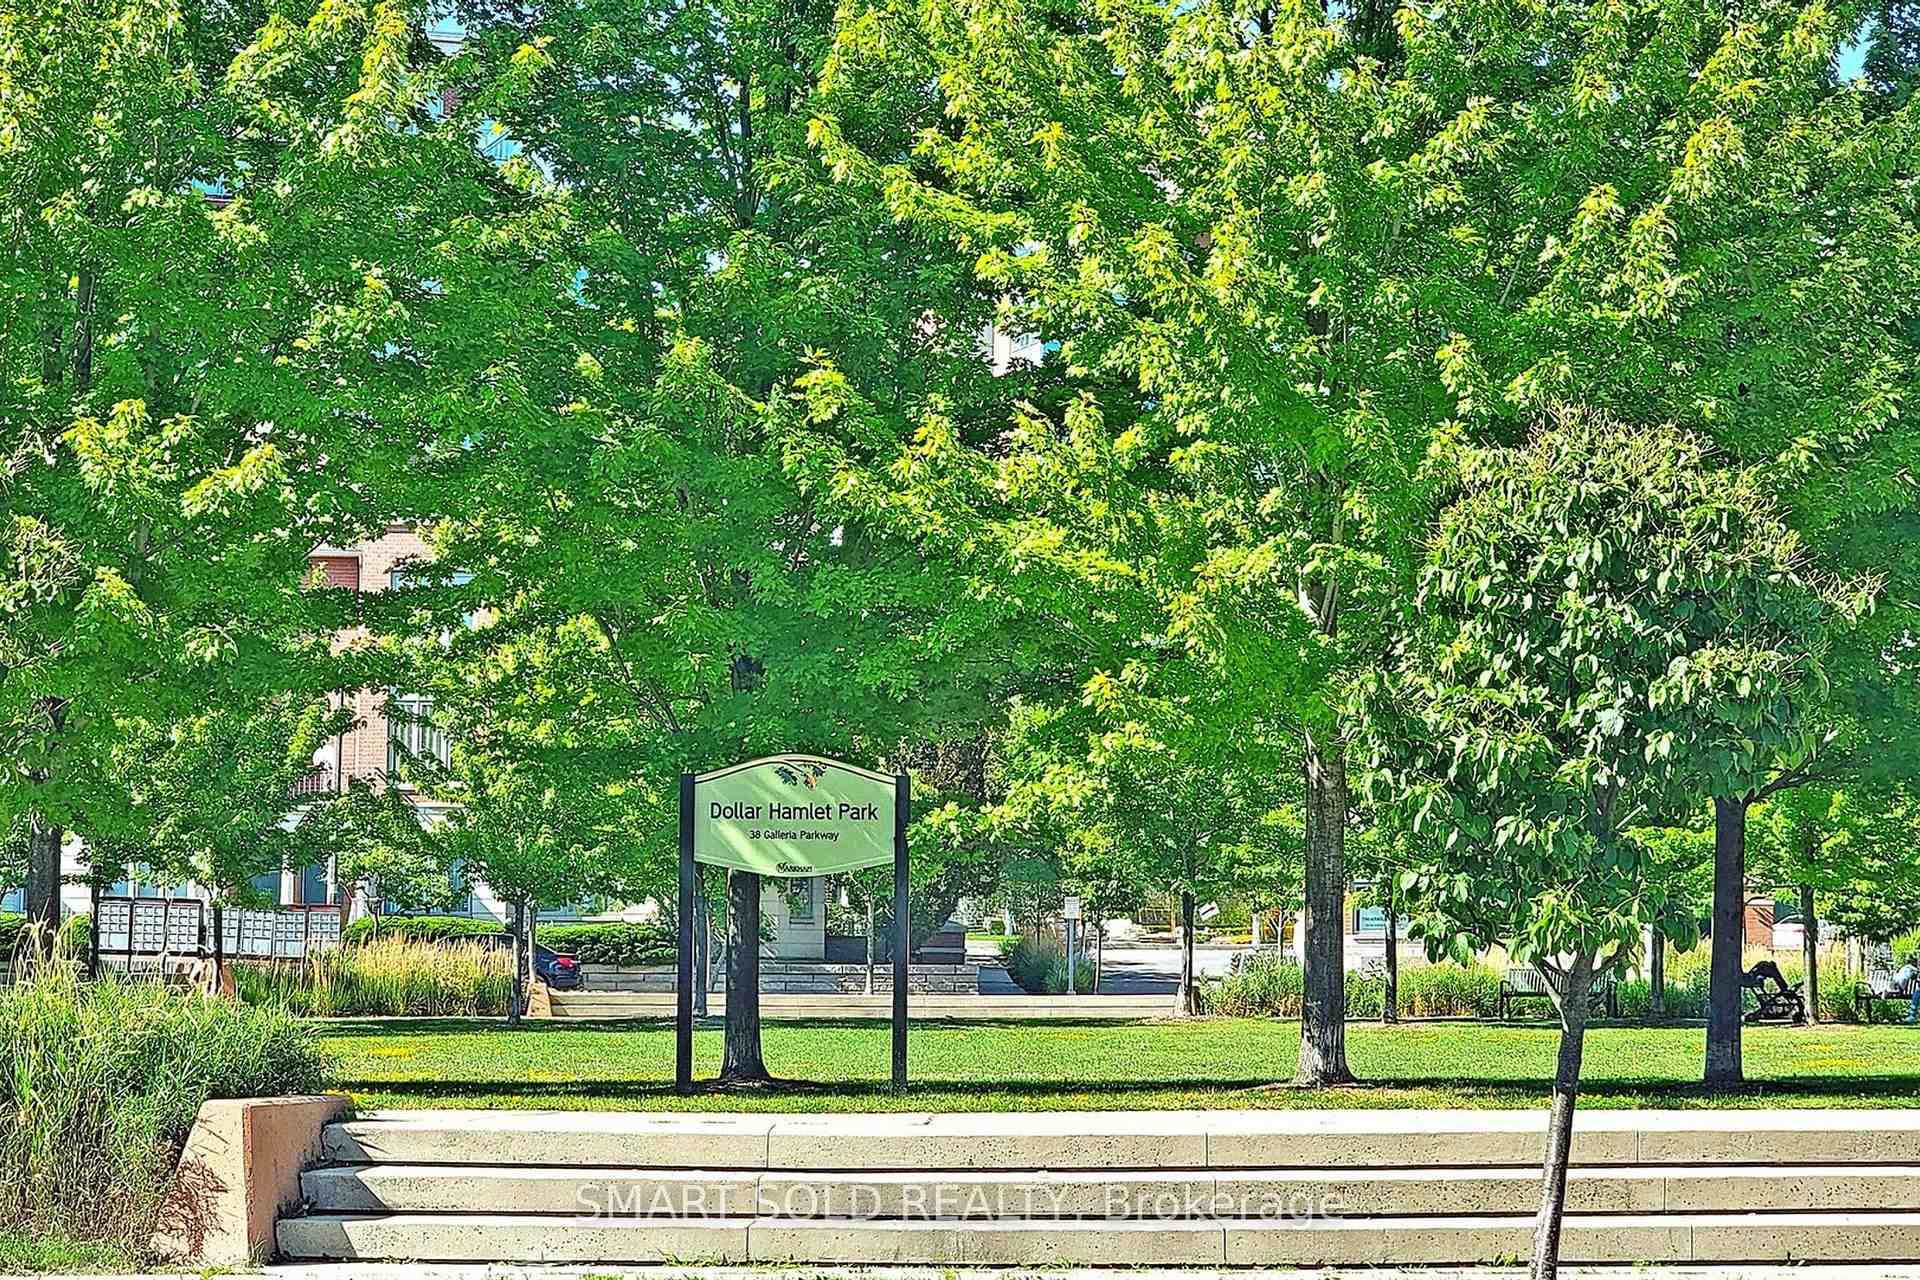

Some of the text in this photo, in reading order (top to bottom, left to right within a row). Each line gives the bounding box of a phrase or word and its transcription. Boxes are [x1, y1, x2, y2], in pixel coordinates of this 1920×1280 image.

[710, 802, 878, 820] Dollar Hamlet Park
[750, 830, 840, 842] 38 Galleria Parkway
